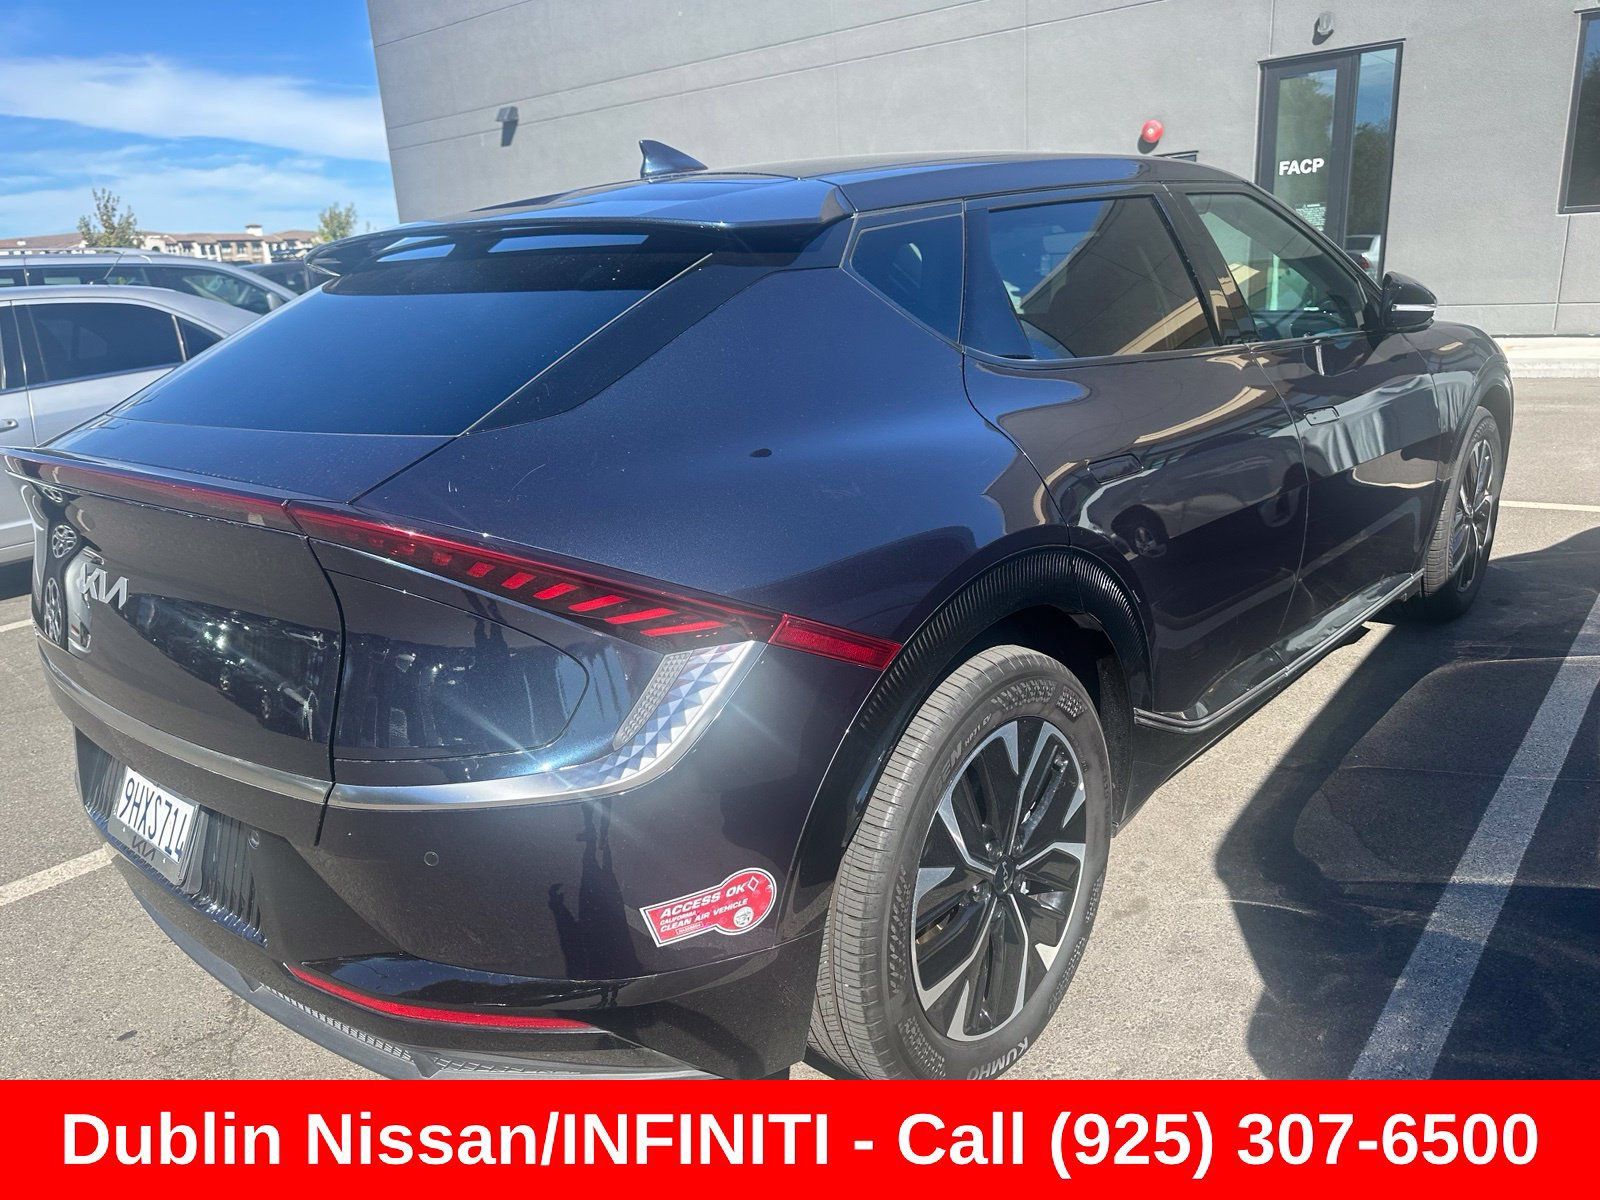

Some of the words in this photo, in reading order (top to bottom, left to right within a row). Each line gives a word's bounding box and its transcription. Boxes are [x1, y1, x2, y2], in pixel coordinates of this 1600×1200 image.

[1279, 158, 1325, 176] FACP
[80, 563, 129, 609] KIA
[131, 835, 157, 862] KIA
[660, 891, 721, 919] ACCESS
[725, 882, 748, 898] OK
[661, 918, 692, 933] CLEAN
[694, 911, 711, 923] AIR
[713, 898, 749, 916] VEHICLE
[966, 1036, 1029, 1080] KUMHO
